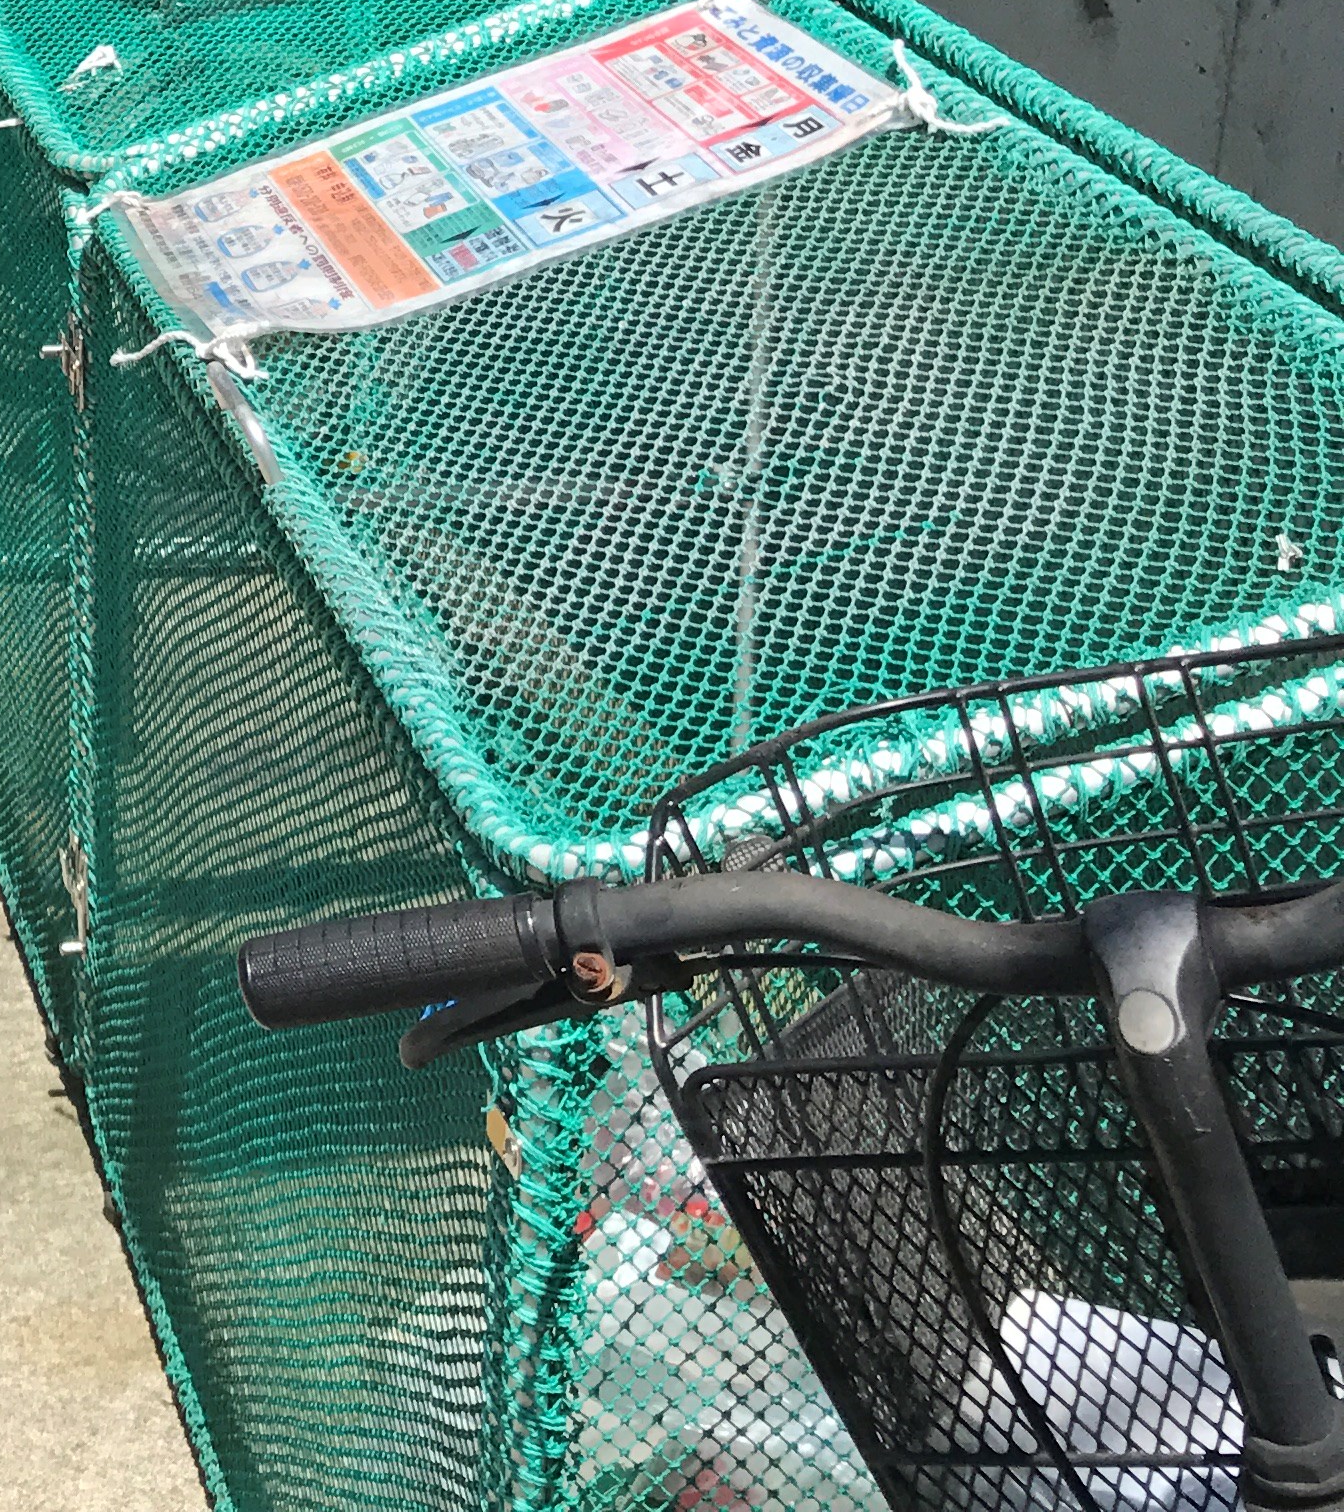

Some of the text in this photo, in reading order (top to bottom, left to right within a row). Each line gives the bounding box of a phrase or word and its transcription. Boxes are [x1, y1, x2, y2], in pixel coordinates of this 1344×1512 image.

[726, 116, 825, 163] 月 金
[636, 171, 685, 196] 土
[540, 207, 587, 233] 火
